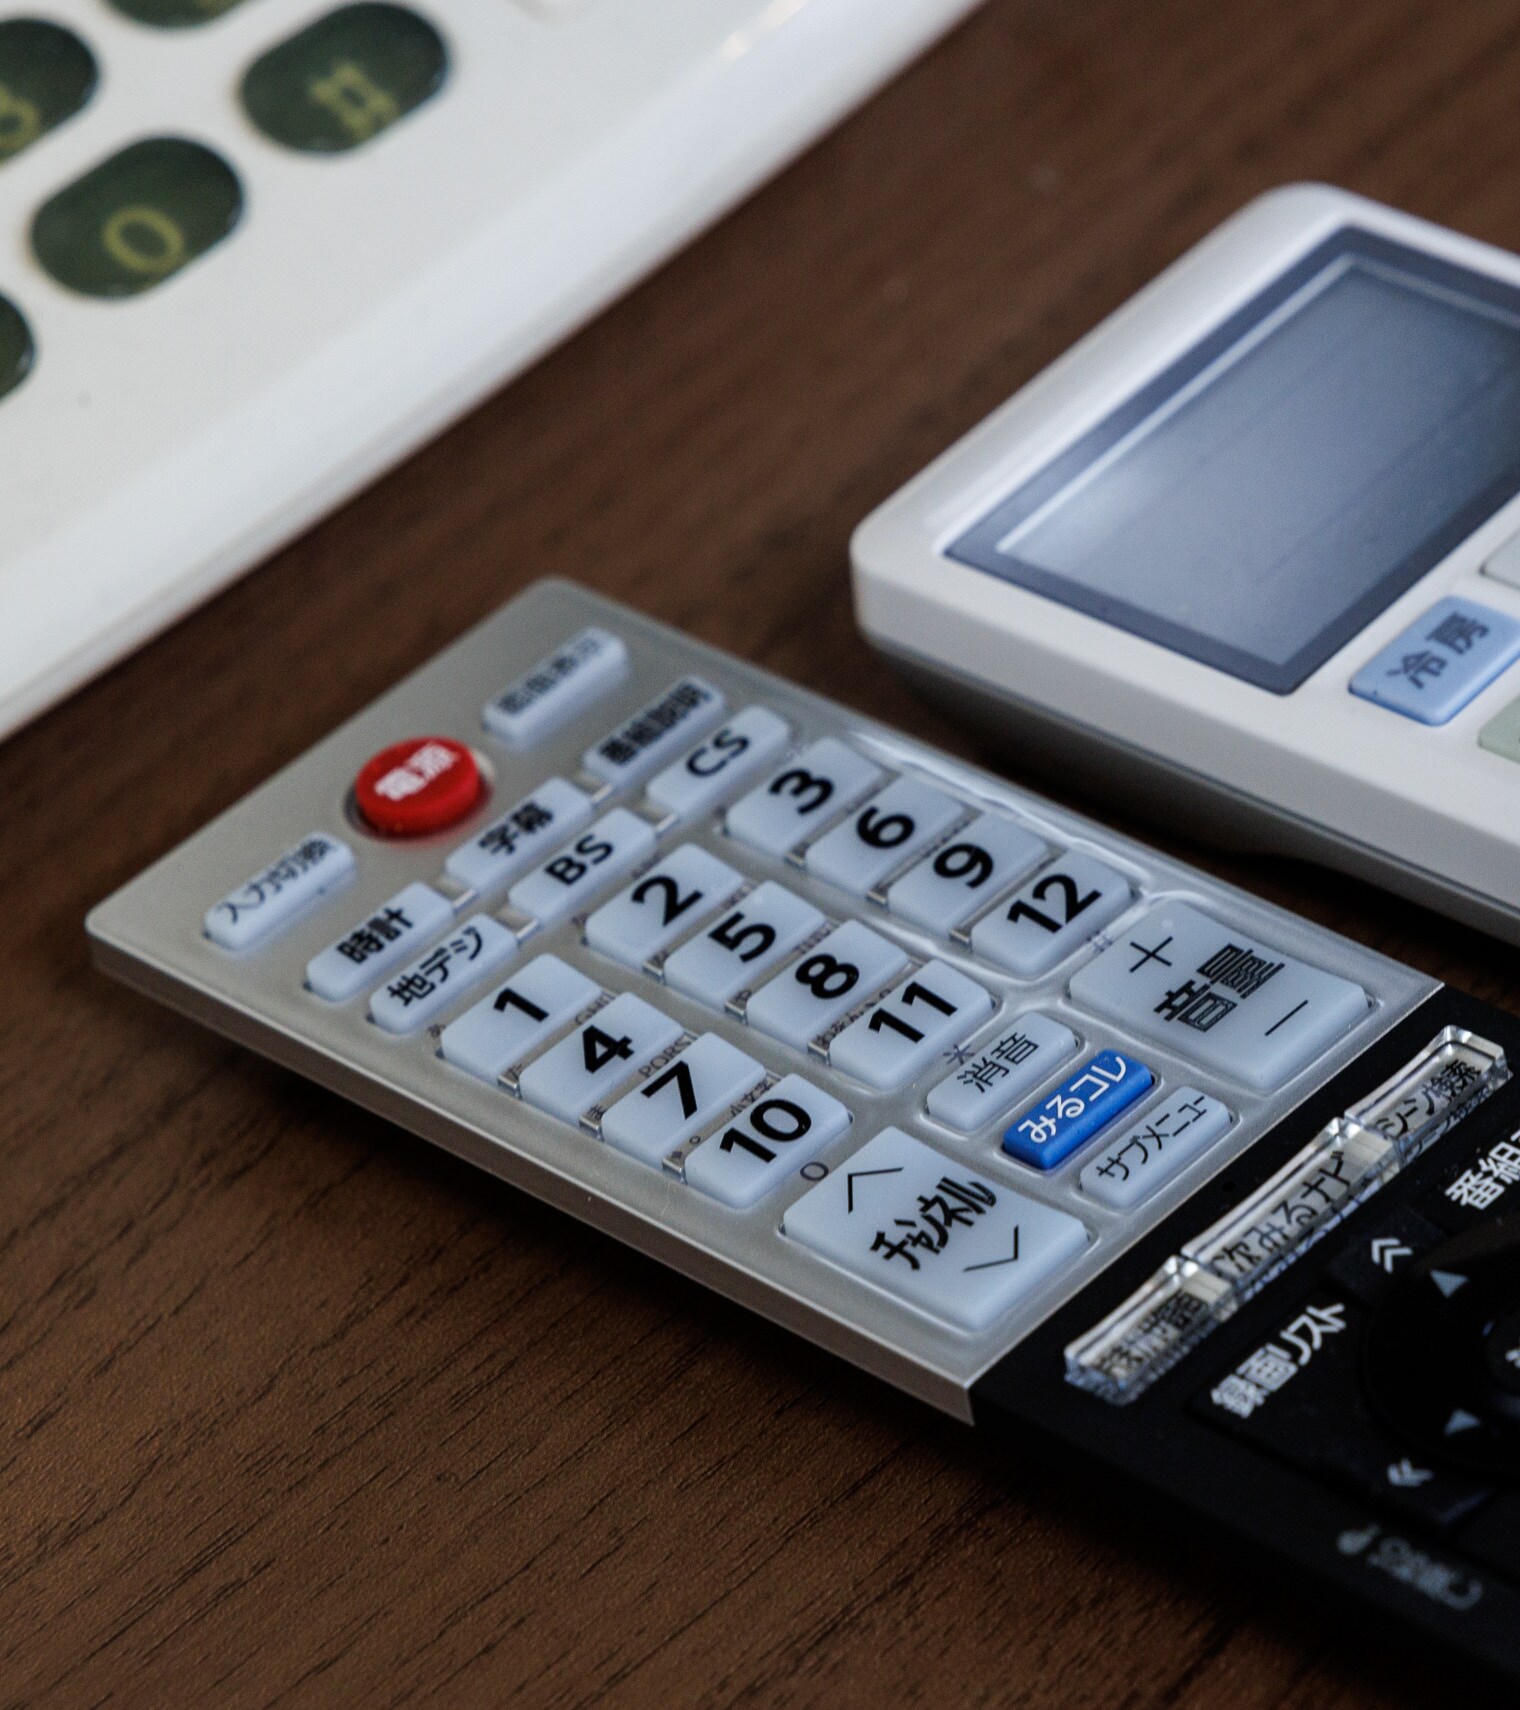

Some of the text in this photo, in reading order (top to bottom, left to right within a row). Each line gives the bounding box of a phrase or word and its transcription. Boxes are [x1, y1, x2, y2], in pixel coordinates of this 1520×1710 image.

[1386, 611, 1490, 690] 冷房
[374, 743, 464, 801] 電源
[686, 727, 750, 778] CS
[768, 768, 834, 816] 3
[479, 799, 556, 856] 字幕
[856, 806, 917, 849] 6
[545, 833, 614, 886] BS
[933, 843, 995, 890] 9
[630, 875, 704, 927] 2
[1005, 873, 1102, 934] 12
[337, 906, 415, 966] 時計
[387, 914, 484, 1009] 地デジ
[707, 911, 777, 963] 5
[493, 987, 549, 1023] 1
[794, 953, 860, 1000] 8
[1155, 943, 1286, 1032] 音量
[867, 980, 959, 1044] 11
[582, 1024, 635, 1074] 4
[964, 1034, 1039, 1093] 消音
[640, 1060, 698, 1121] 7
[1017, 1055, 1127, 1145] みるコレ
[719, 1098, 812, 1163] 10
[1098, 1095, 1206, 1182] サブメニュー
[871, 1175, 997, 1271] チャンネル
[1211, 1302, 1347, 1419] 録画リスト
